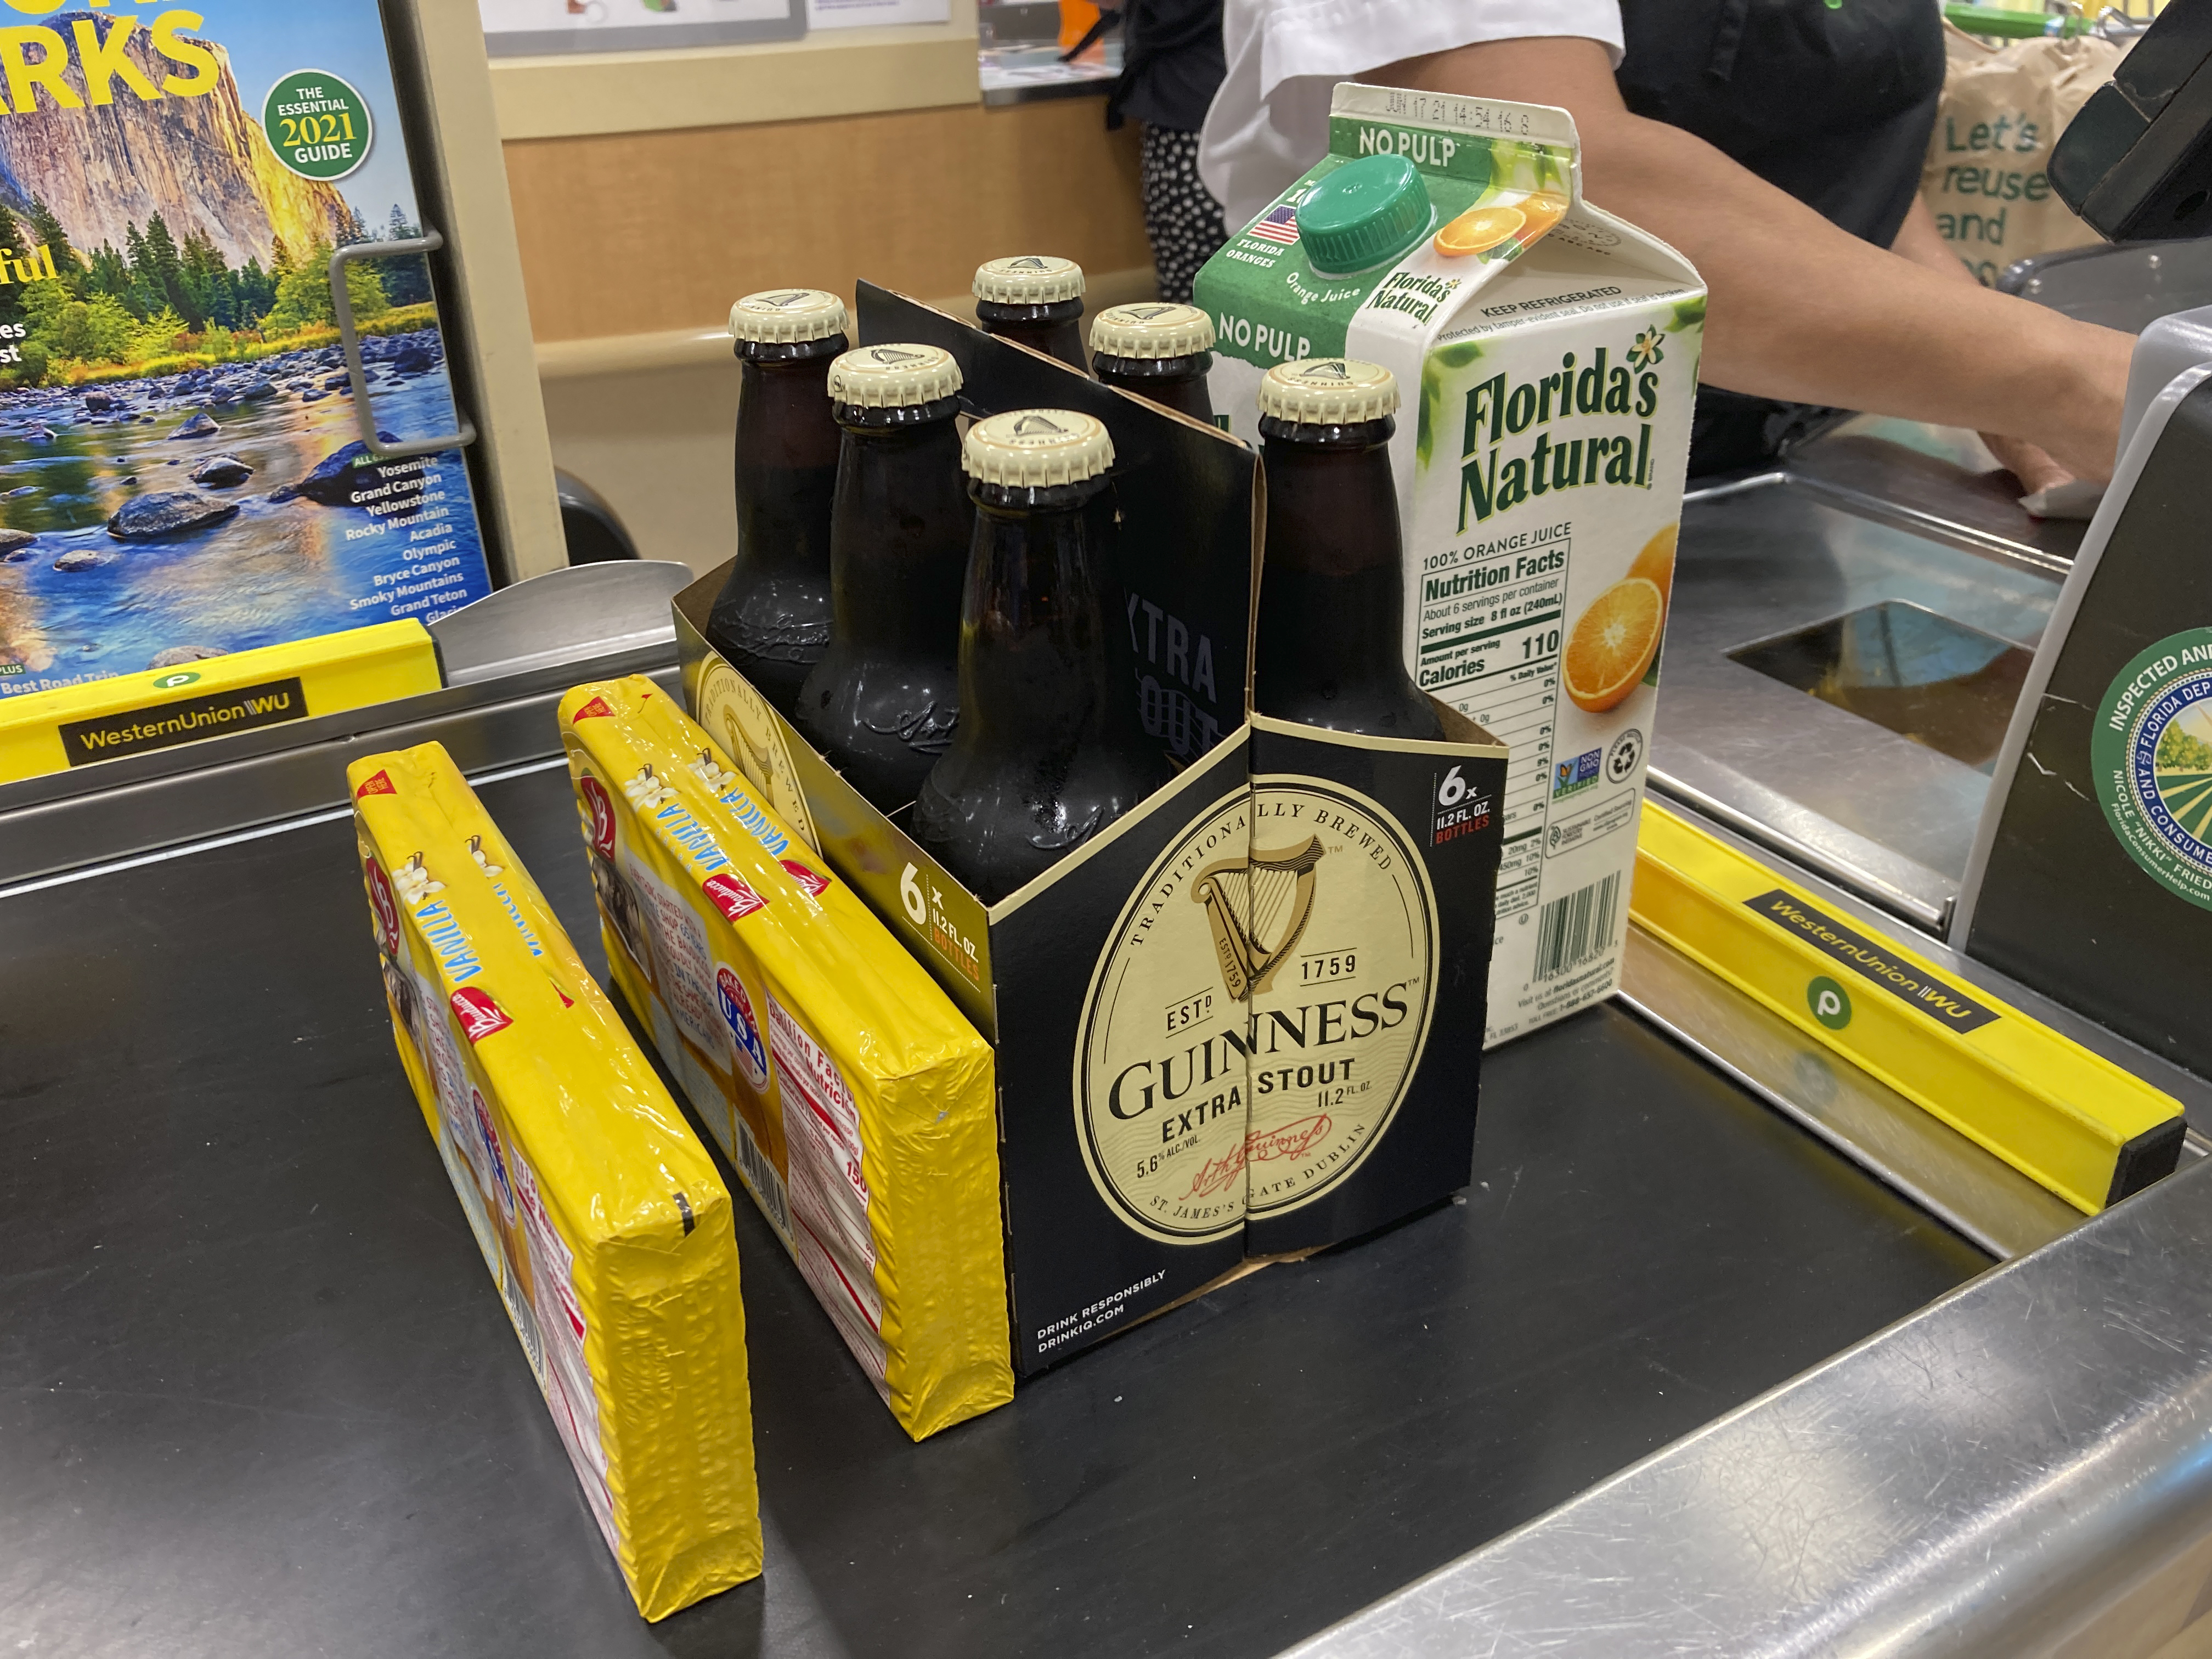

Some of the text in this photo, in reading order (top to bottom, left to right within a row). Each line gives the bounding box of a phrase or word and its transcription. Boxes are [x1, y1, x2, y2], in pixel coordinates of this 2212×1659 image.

[0, 10, 219, 115] RKS
[277, 98, 349, 116] ESSENTIAL
[296, 87, 324, 99] THE
[279, 112, 357, 146] 2021
[1359, 126, 1455, 167] NO PULP
[1946, 112, 2039, 153] Let's
[295, 143, 353, 163] GUIDE
[1943, 165, 2050, 201] reuse
[1936, 207, 2007, 246] and
[1226, 250, 1276, 268] ORANGES
[1237, 239, 1285, 257] FLORIDA
[1286, 272, 1361, 305] Orange Juice
[1366, 290, 1437, 325] Natural
[1480, 286, 1622, 317] KEEP REFRIGERATED
[1218, 311, 1311, 362] NO PULP
[1437, 325, 1481, 341] Protected
[1480, 324, 1493, 332] by
[1493, 311, 1561, 329] tamper-evident
[1579, 303, 1594, 313] Do
[354, 454, 372, 466] ALL
[376, 456, 439, 478] Yosemite
[1456, 423, 1652, 535] Natural
[350, 473, 442, 504] Grand Canyon
[365, 489, 446, 517] Yellowstone
[346, 506, 450, 541] Rocky Mountain
[410, 523, 453, 543] Acadia
[403, 538, 457, 561] Olympic
[1423, 522, 1572, 571] 100% ORANGE JUICE
[373, 556, 460, 587] Bryce Canyon
[1425, 549, 1565, 602] Nutrition Facts
[349, 572, 465, 611] Smoky Mountains
[391, 589, 468, 617] Grand Teton
[1423, 578, 1560, 622] About 6 servings per container
[1421, 592, 1563, 640] Serving size 8 fl oz (240mL)
[1420, 629, 1560, 667] Amount per serving 110
[1, 680, 38, 695] Best
[1419, 659, 1485, 688] Calories
[2108, 654, 2179, 732] INSPECTED
[80, 692, 290, 750] WesternUnion WU
[2140, 696, 2183, 748] FLORIDA
[704, 677, 805, 831] TRADITIONALLY BREWED
[1579, 759, 1599, 773] GMO
[1580, 750, 1601, 763] NON
[2113, 769, 2136, 819] NICOLE
[2137, 768, 2156, 800] AND
[719, 786, 789, 856] VANILLA
[1435, 814, 1490, 845] BOTTLES
[1436, 800, 1491, 830] 11.2 FL. OZ.
[656, 802, 730, 872] VANILLA
[2111, 802, 2211, 901] FloridaConsumerHelp.com
[900, 861, 927, 926] 6
[1130, 803, 1392, 947] TRADITIONALLY BREWED
[415, 899, 484, 983] VANILLA
[932, 907, 979, 963] 11.2 FL. OZ.
[934, 926, 980, 981] BOTTLES
[1224, 961, 1242, 988] 1759
[1300, 953, 1356, 980] 1759
[1769, 900, 1972, 1018] WesternUnion WU
[1108, 981, 1408, 1121] GUINNESS
[1161, 1057, 1356, 1144] EXTRA STOUT
[1317, 1086, 1345, 1108] 11.2
[1149, 1195, 1169, 1214] ST.
[1242, 1176, 1296, 1206] GATE
[1302, 1122, 1366, 1180] DUBLIN
[1037, 1269, 1166, 1340] DRINK RESPONSIBLY
[1038, 1304, 1125, 1353] DRINKIQ.COM
